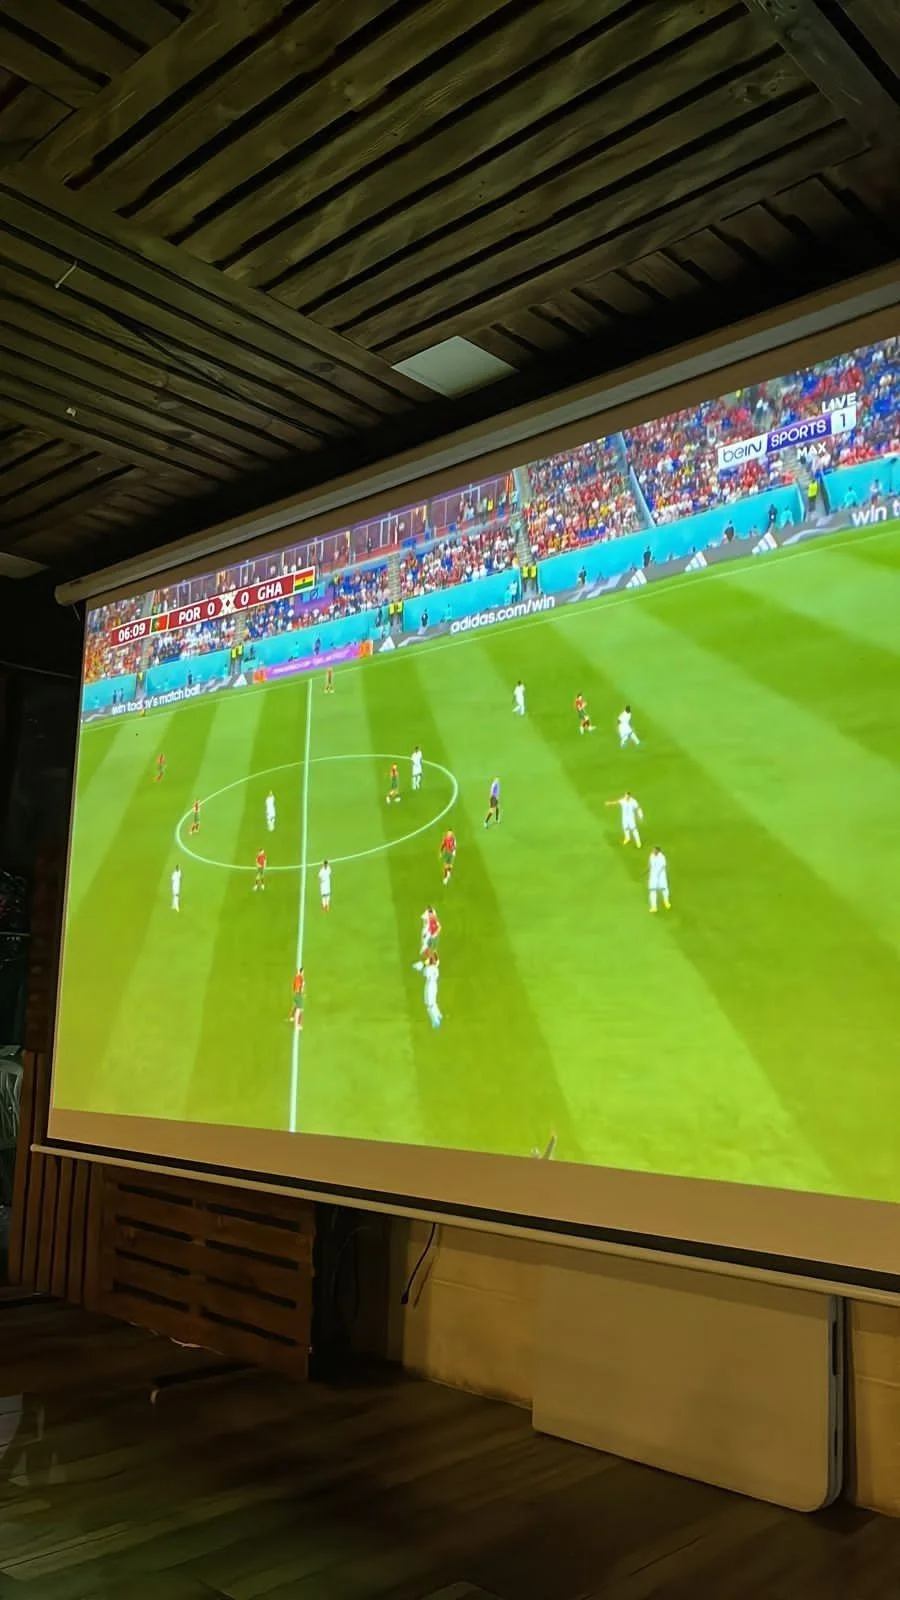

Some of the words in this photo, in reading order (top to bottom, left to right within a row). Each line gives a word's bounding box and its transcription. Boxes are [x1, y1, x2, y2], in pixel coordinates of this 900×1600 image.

[822, 392, 857, 413] LIVE
[771, 420, 827, 447] SPORTS
[839, 413, 847, 428] 1
[797, 441, 827, 459] MAX
[852, 504, 888, 527] win
[118, 622, 146, 642] 06:09
[178, 608, 201, 625] POR
[207, 603, 215, 616] 0
[241, 593, 249, 606] 0
[257, 582, 283, 601] GHA
[451, 594, 556, 633] adidas.com/win
[159, 688, 184, 705] match
